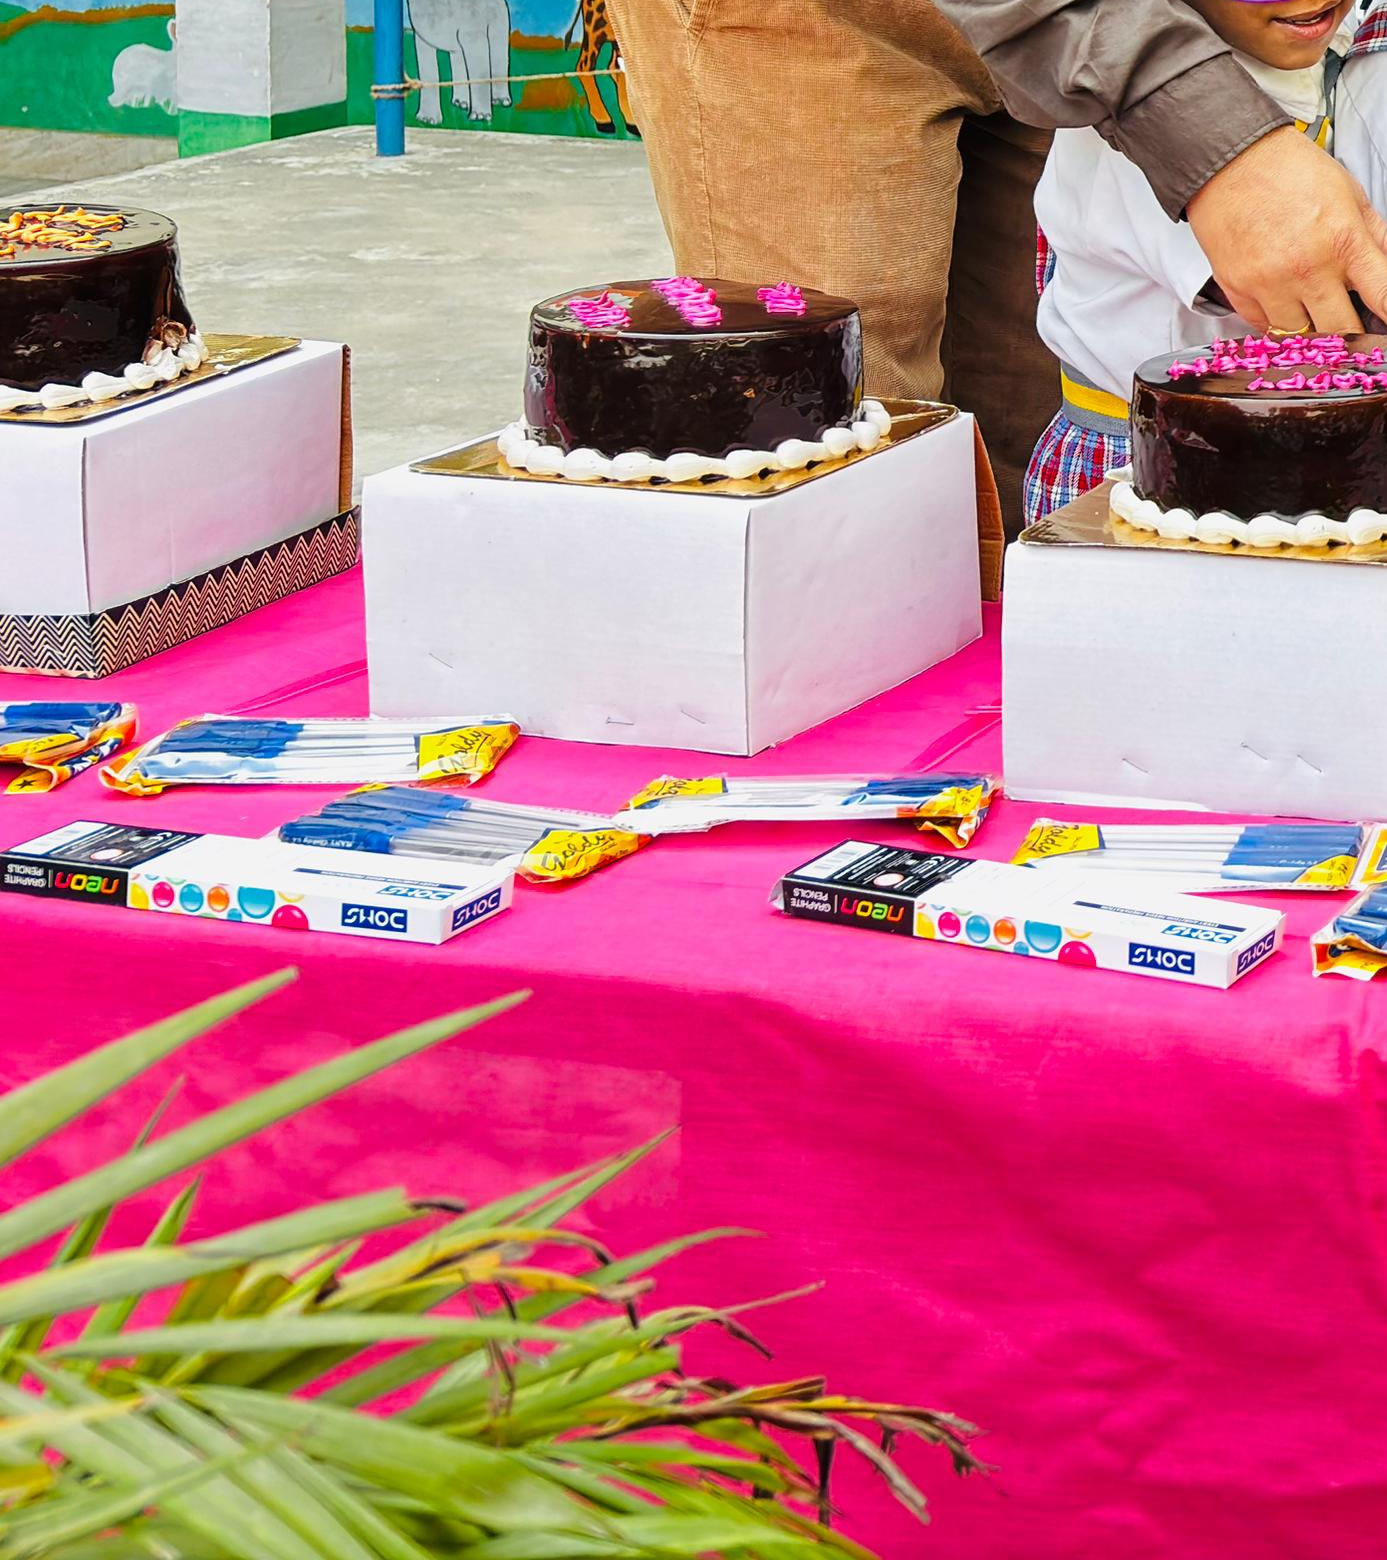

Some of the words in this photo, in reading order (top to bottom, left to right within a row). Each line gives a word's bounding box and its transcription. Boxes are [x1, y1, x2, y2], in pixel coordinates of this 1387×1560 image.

[542, 831, 615, 872] Goldy
[3, 873, 48, 889] GRAPHITE
[7, 862, 45, 878] PENCILS
[54, 871, 120, 895] neon
[793, 887, 830, 902] PENCILS
[453, 890, 500, 929] DOMS
[790, 896, 832, 914] GRAPHITE
[841, 896, 905, 922] neon
[343, 906, 406, 930] DOMS
[1131, 946, 1193, 972] DOMS
[1237, 932, 1275, 973] DOMS
